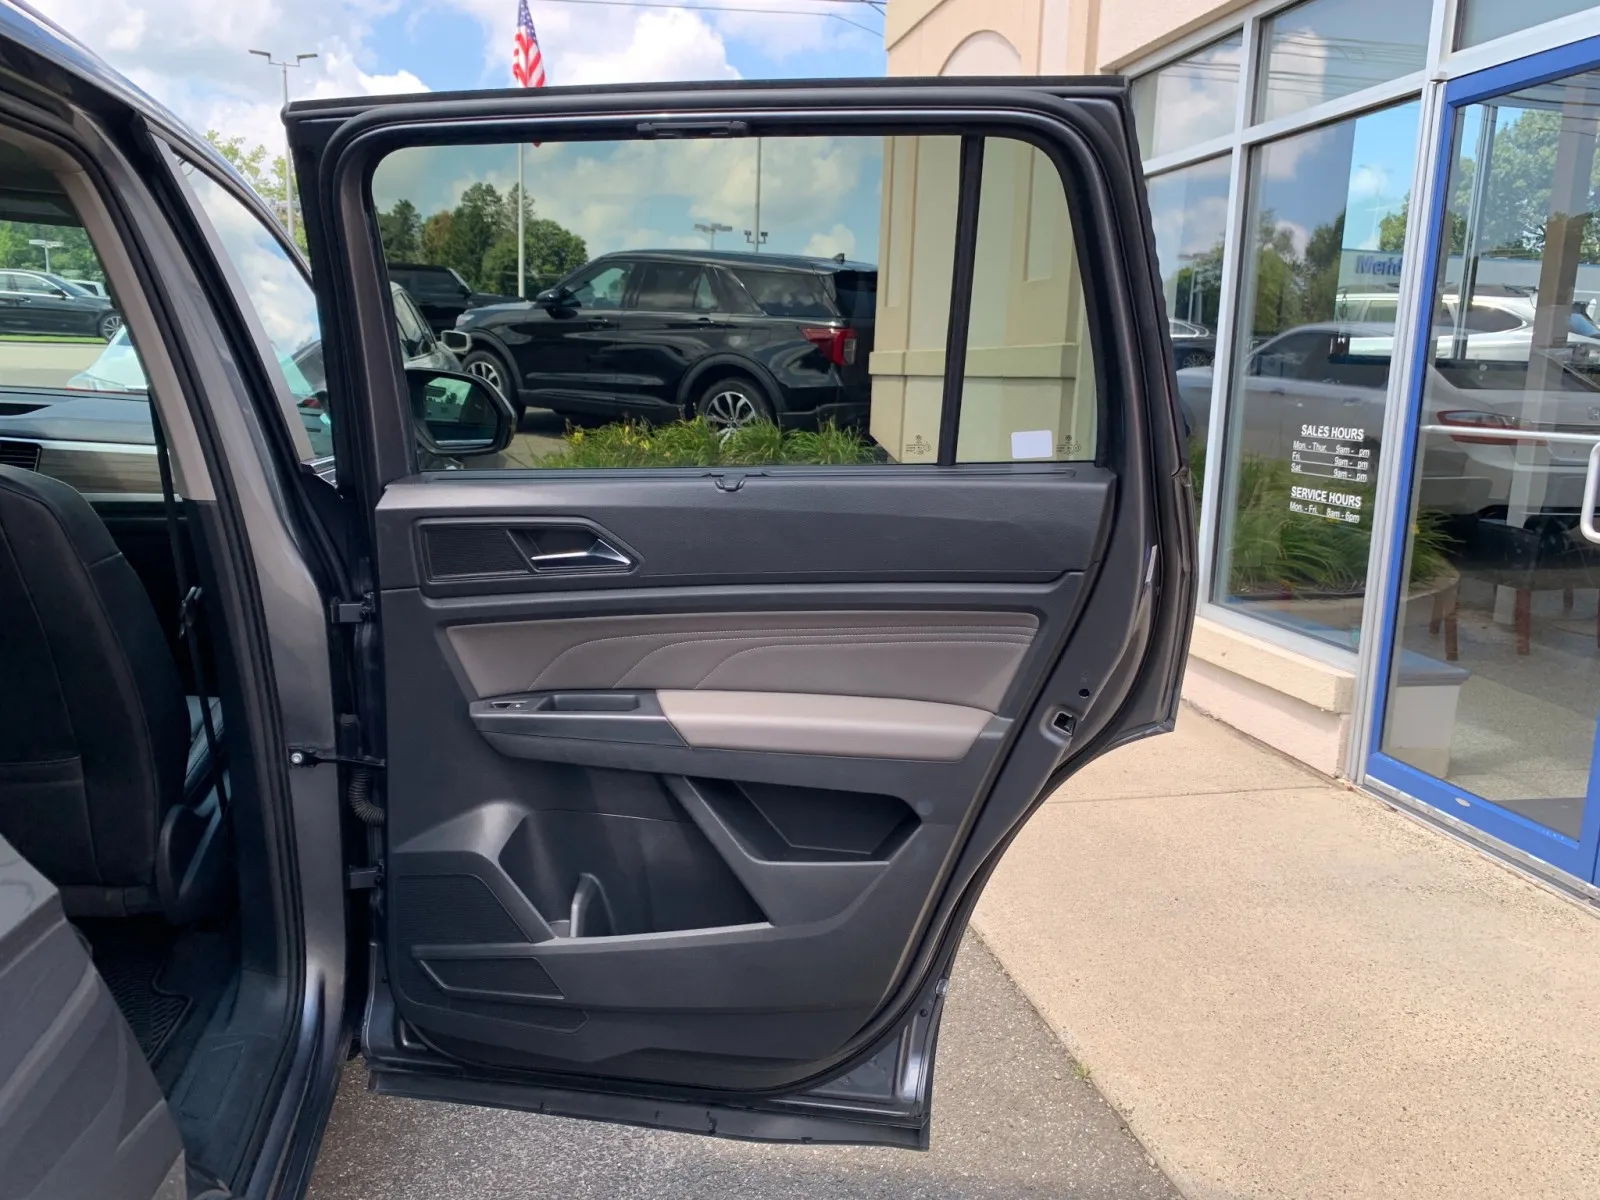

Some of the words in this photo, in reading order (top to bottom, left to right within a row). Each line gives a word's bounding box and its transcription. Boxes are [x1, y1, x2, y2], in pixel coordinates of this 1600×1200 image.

[1301, 424, 1330, 437] SALES
[1331, 426, 1365, 440] HOURS
[1293, 440, 1306, 450] Mon.
[1312, 442, 1327, 452] Thur.
[1359, 448, 1370, 458] pm
[1357, 460, 1369, 470] pm
[1356, 473, 1367, 482] pm
[1291, 486, 1328, 502] SERVICE
[1329, 492, 1362, 508] HOURS
[1290, 501, 1303, 512] Mon.
